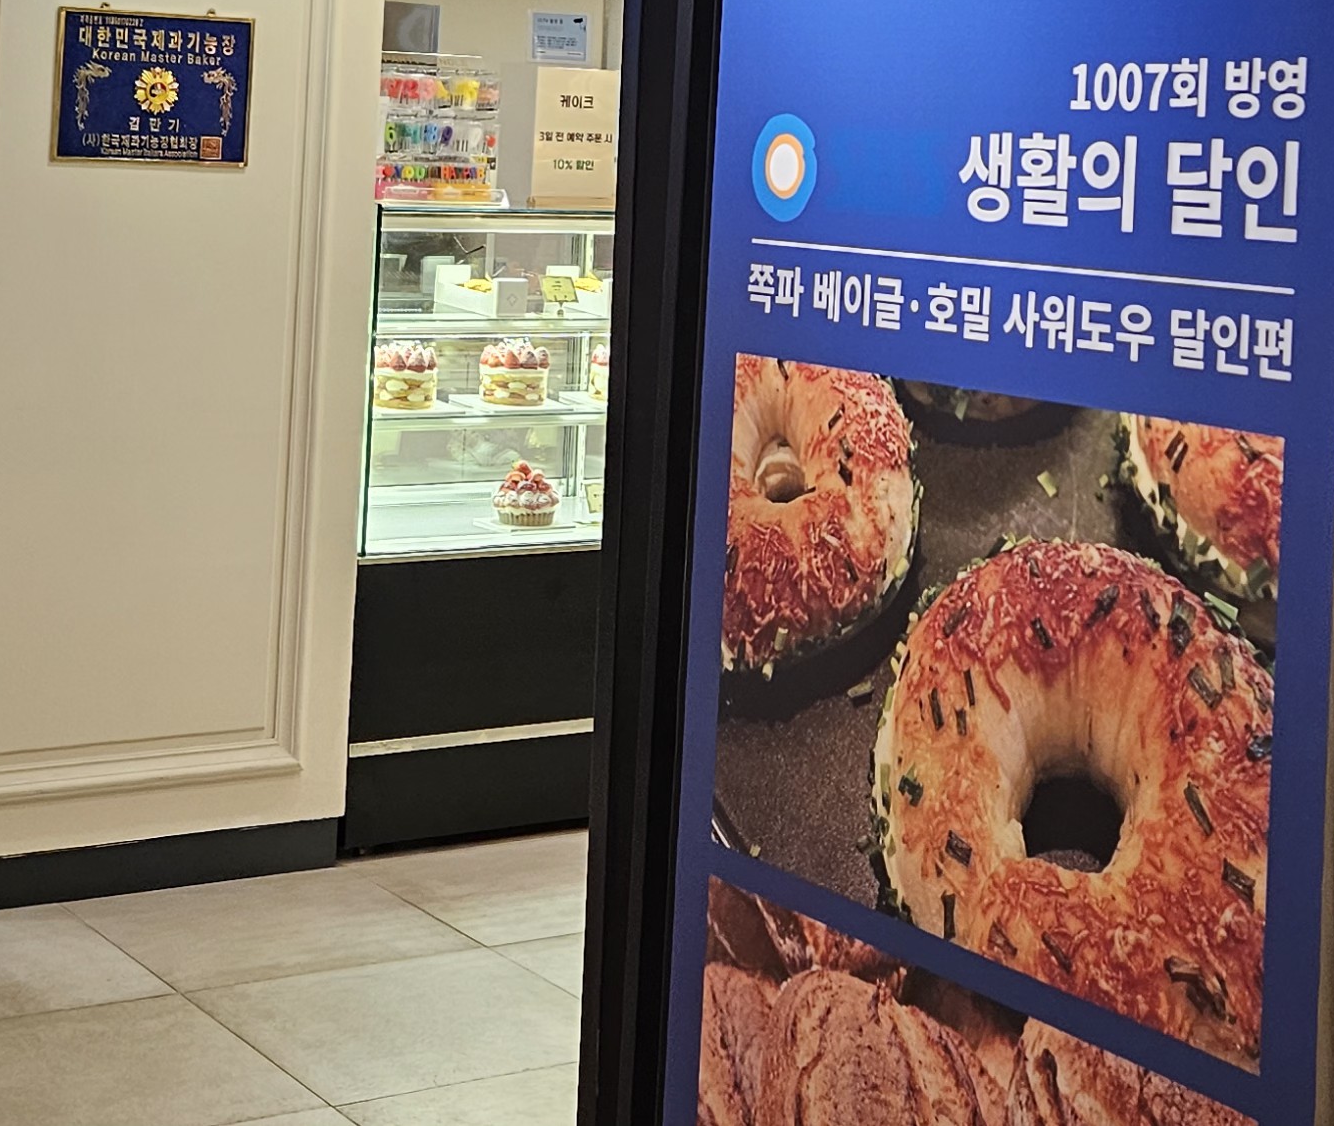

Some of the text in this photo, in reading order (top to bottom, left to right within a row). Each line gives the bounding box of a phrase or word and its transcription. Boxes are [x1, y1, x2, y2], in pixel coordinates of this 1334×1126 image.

[78, 25, 236, 56] 대한민국제과기능장
[92, 48, 222, 66] Korean Master Baker
[1070, 56, 1308, 120] 1007회 방영
[539, 131, 553, 142] 3일
[555, 131, 564, 142] 전
[553, 159, 595, 171] 10% 할인
[959, 131, 1301, 244] 생활의 달인
[746, 262, 804, 317] 쪽파
[1003, 290, 1156, 363] 사워도우
[1169, 308, 1294, 382] 달인편
